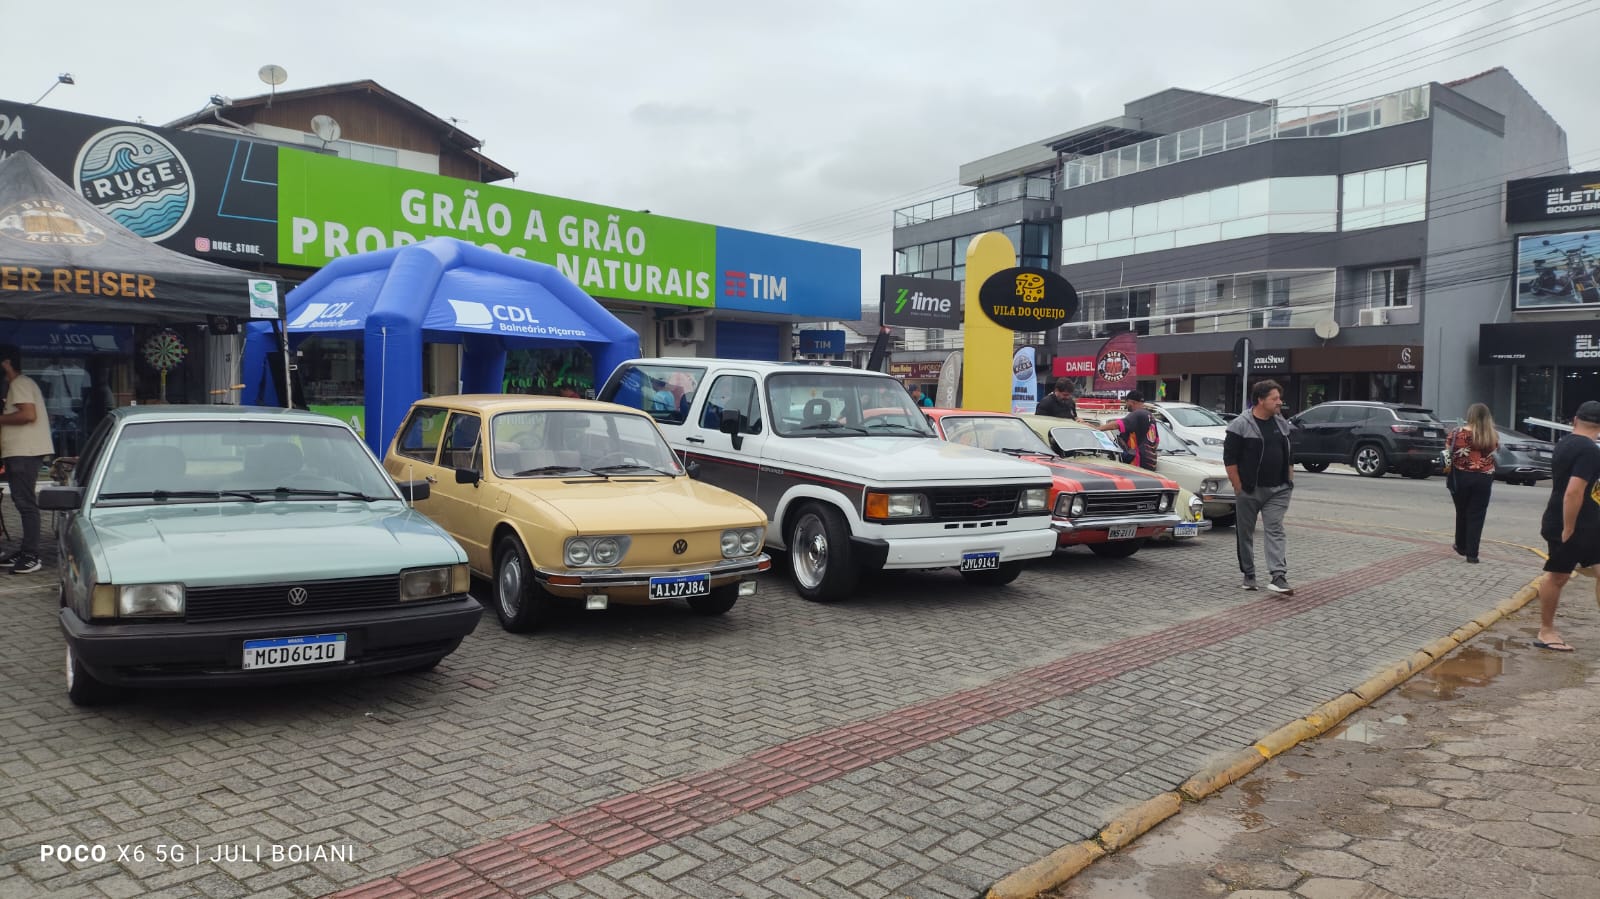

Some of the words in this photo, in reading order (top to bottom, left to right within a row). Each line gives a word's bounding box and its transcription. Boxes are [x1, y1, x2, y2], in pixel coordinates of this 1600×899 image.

[93, 162, 176, 198] RUGE
[122, 185, 155, 198] STORE
[401, 188, 512, 237] GRÃO
[523, 208, 547, 243] A
[558, 214, 646, 257] GRÃO
[53, 268, 156, 299] REISER
[556, 252, 710, 300] NATURAIS
[749, 272, 787, 303] TIM
[911, 291, 952, 313] time
[993, 305, 1016, 317] VILA
[1018, 306, 1031, 317] DO
[1032, 307, 1065, 320] QUEIJO
[492, 304, 540, 325] CDL
[499, 322, 547, 335] Balneário
[547, 326, 587, 338] Piçarras
[814, 340, 832, 350] TIM
[1065, 360, 1096, 372] DANIEL
[655, 580, 705, 597] AIJ7J84
[255, 643, 335, 666] MCD6C10
